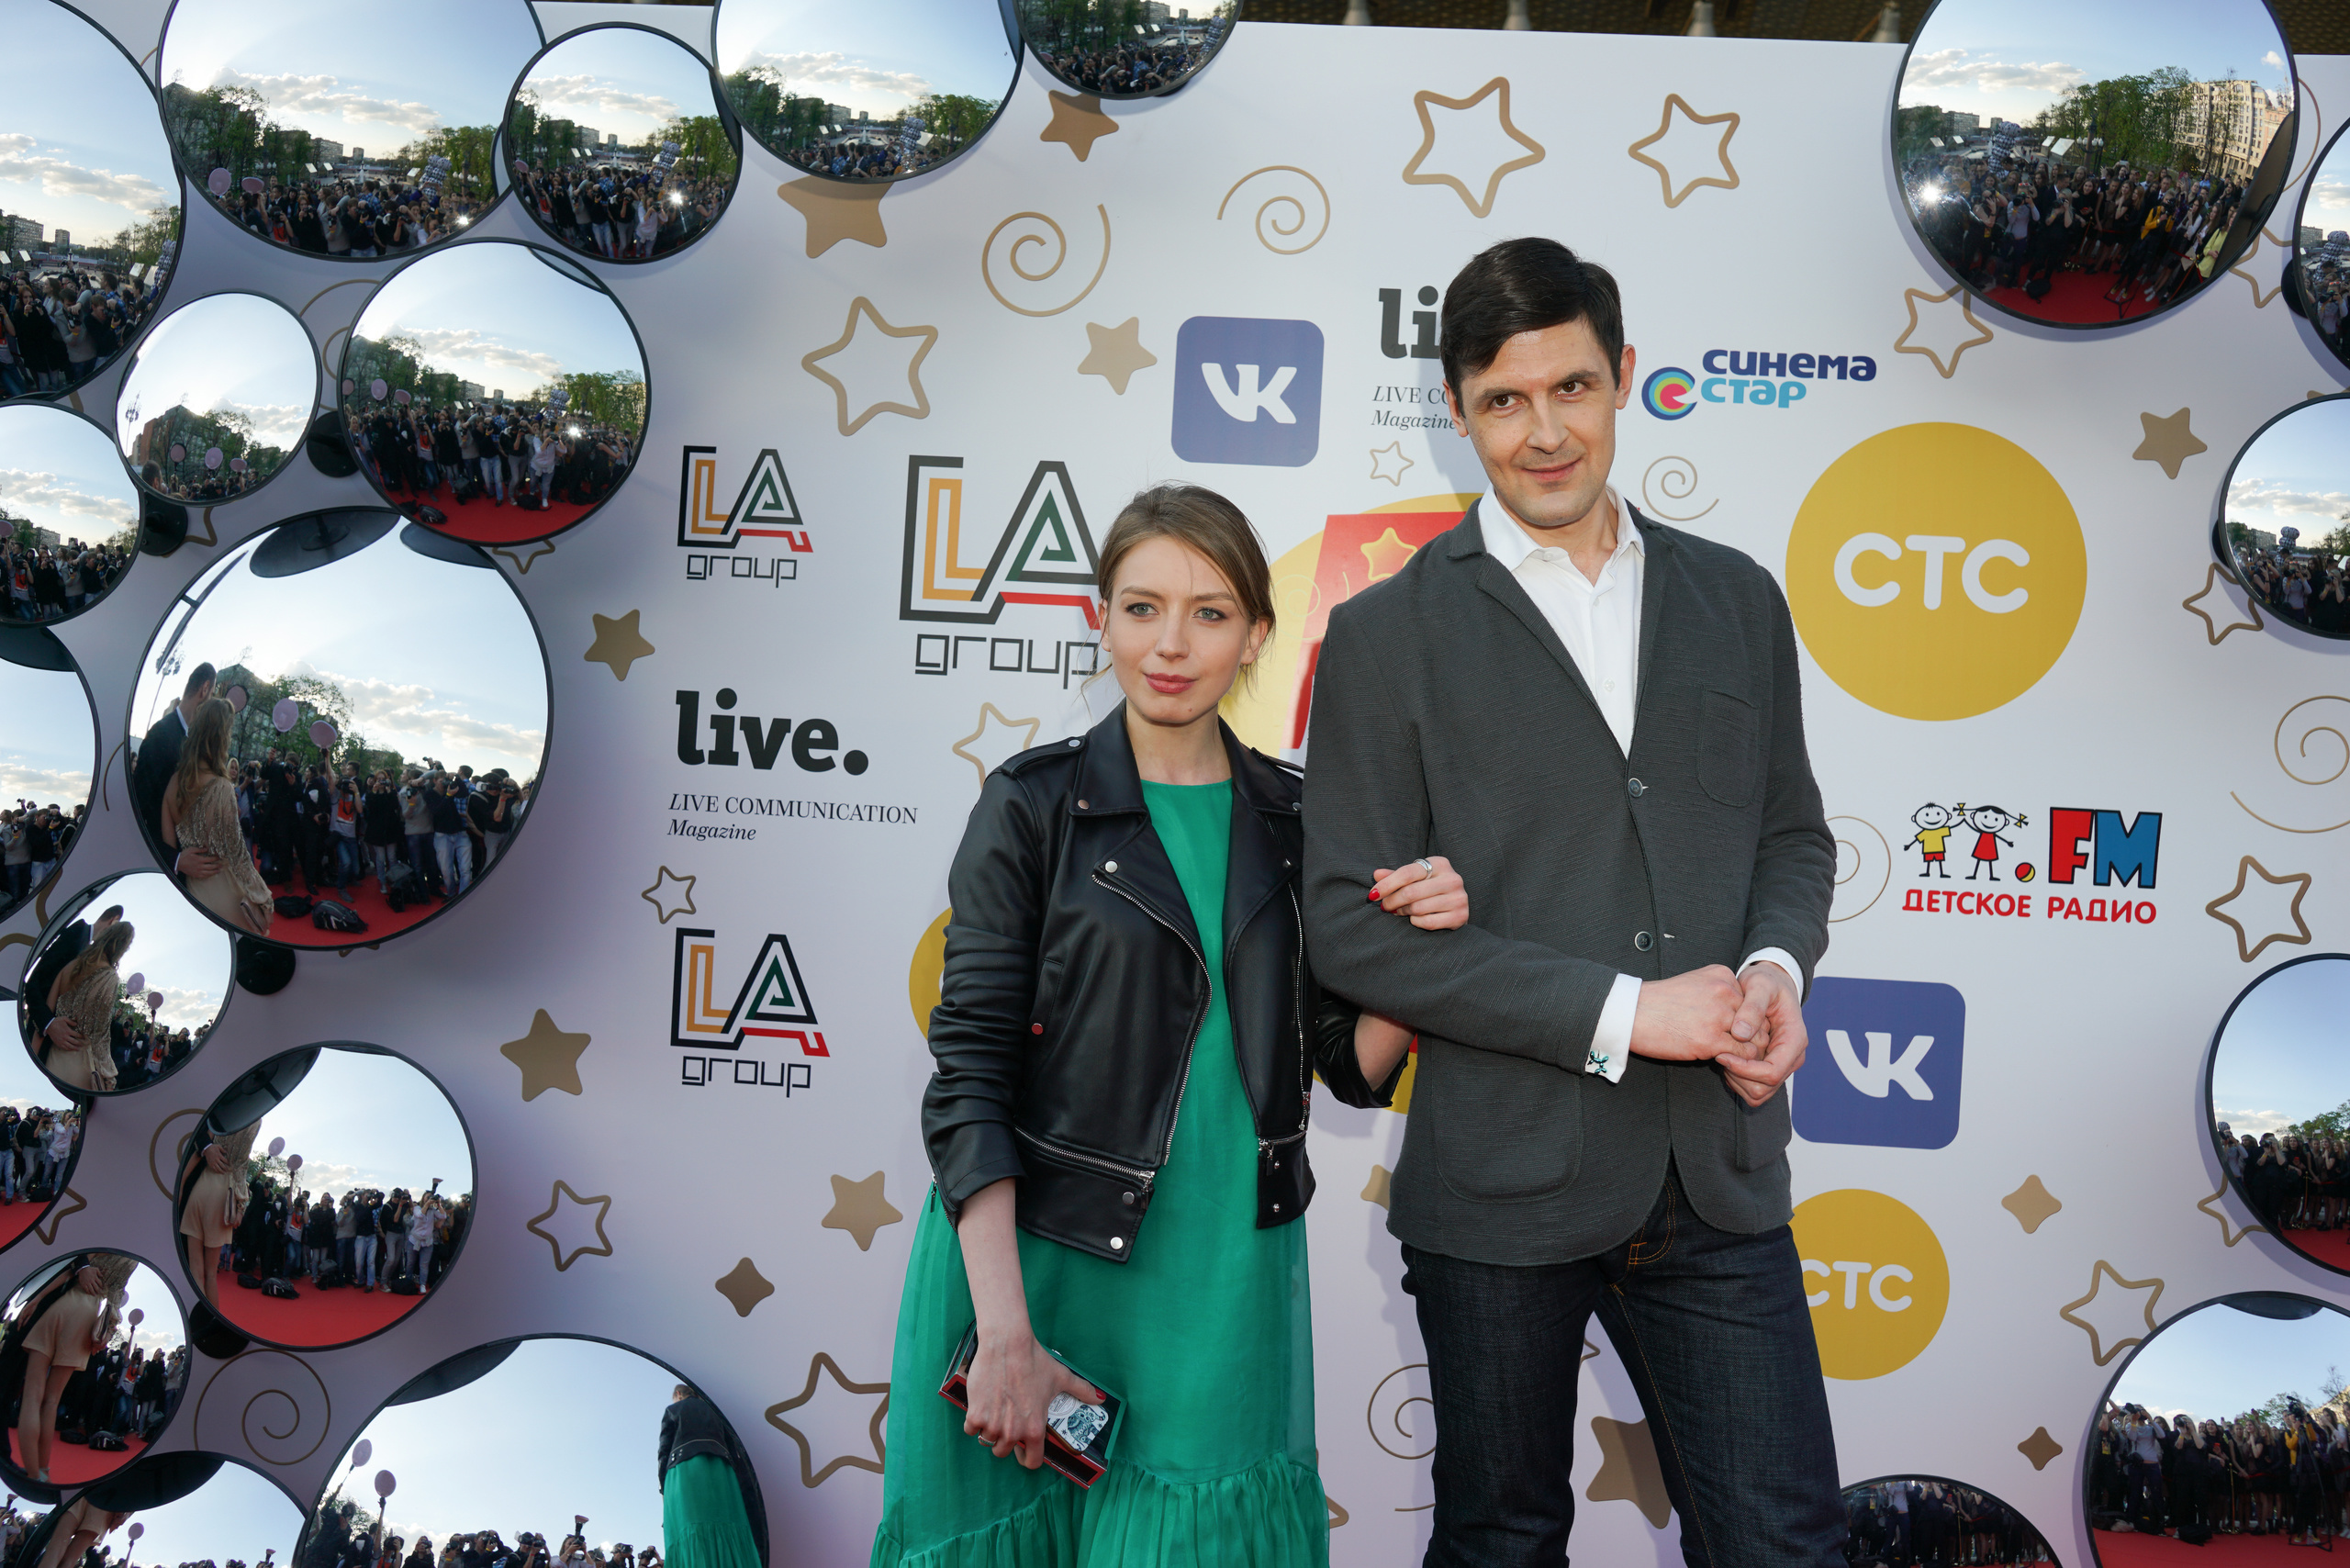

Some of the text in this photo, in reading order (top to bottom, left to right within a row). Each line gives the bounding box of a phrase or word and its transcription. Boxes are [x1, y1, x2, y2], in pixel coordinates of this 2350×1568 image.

[1372, 386, 1421, 404] LIVE
[1371, 409, 1455, 430] Magazine
[687, 554, 797, 588] group
[915, 633, 1098, 689] group
[676, 688, 869, 776] live.
[668, 793, 918, 824] LIVE COMMUNICATION
[667, 818, 756, 842] Magazine
[2048, 806, 2163, 889] FM
[1902, 889, 2157, 924] ДЕТСКОЕ РАДИО
[681, 1056, 811, 1098] group
